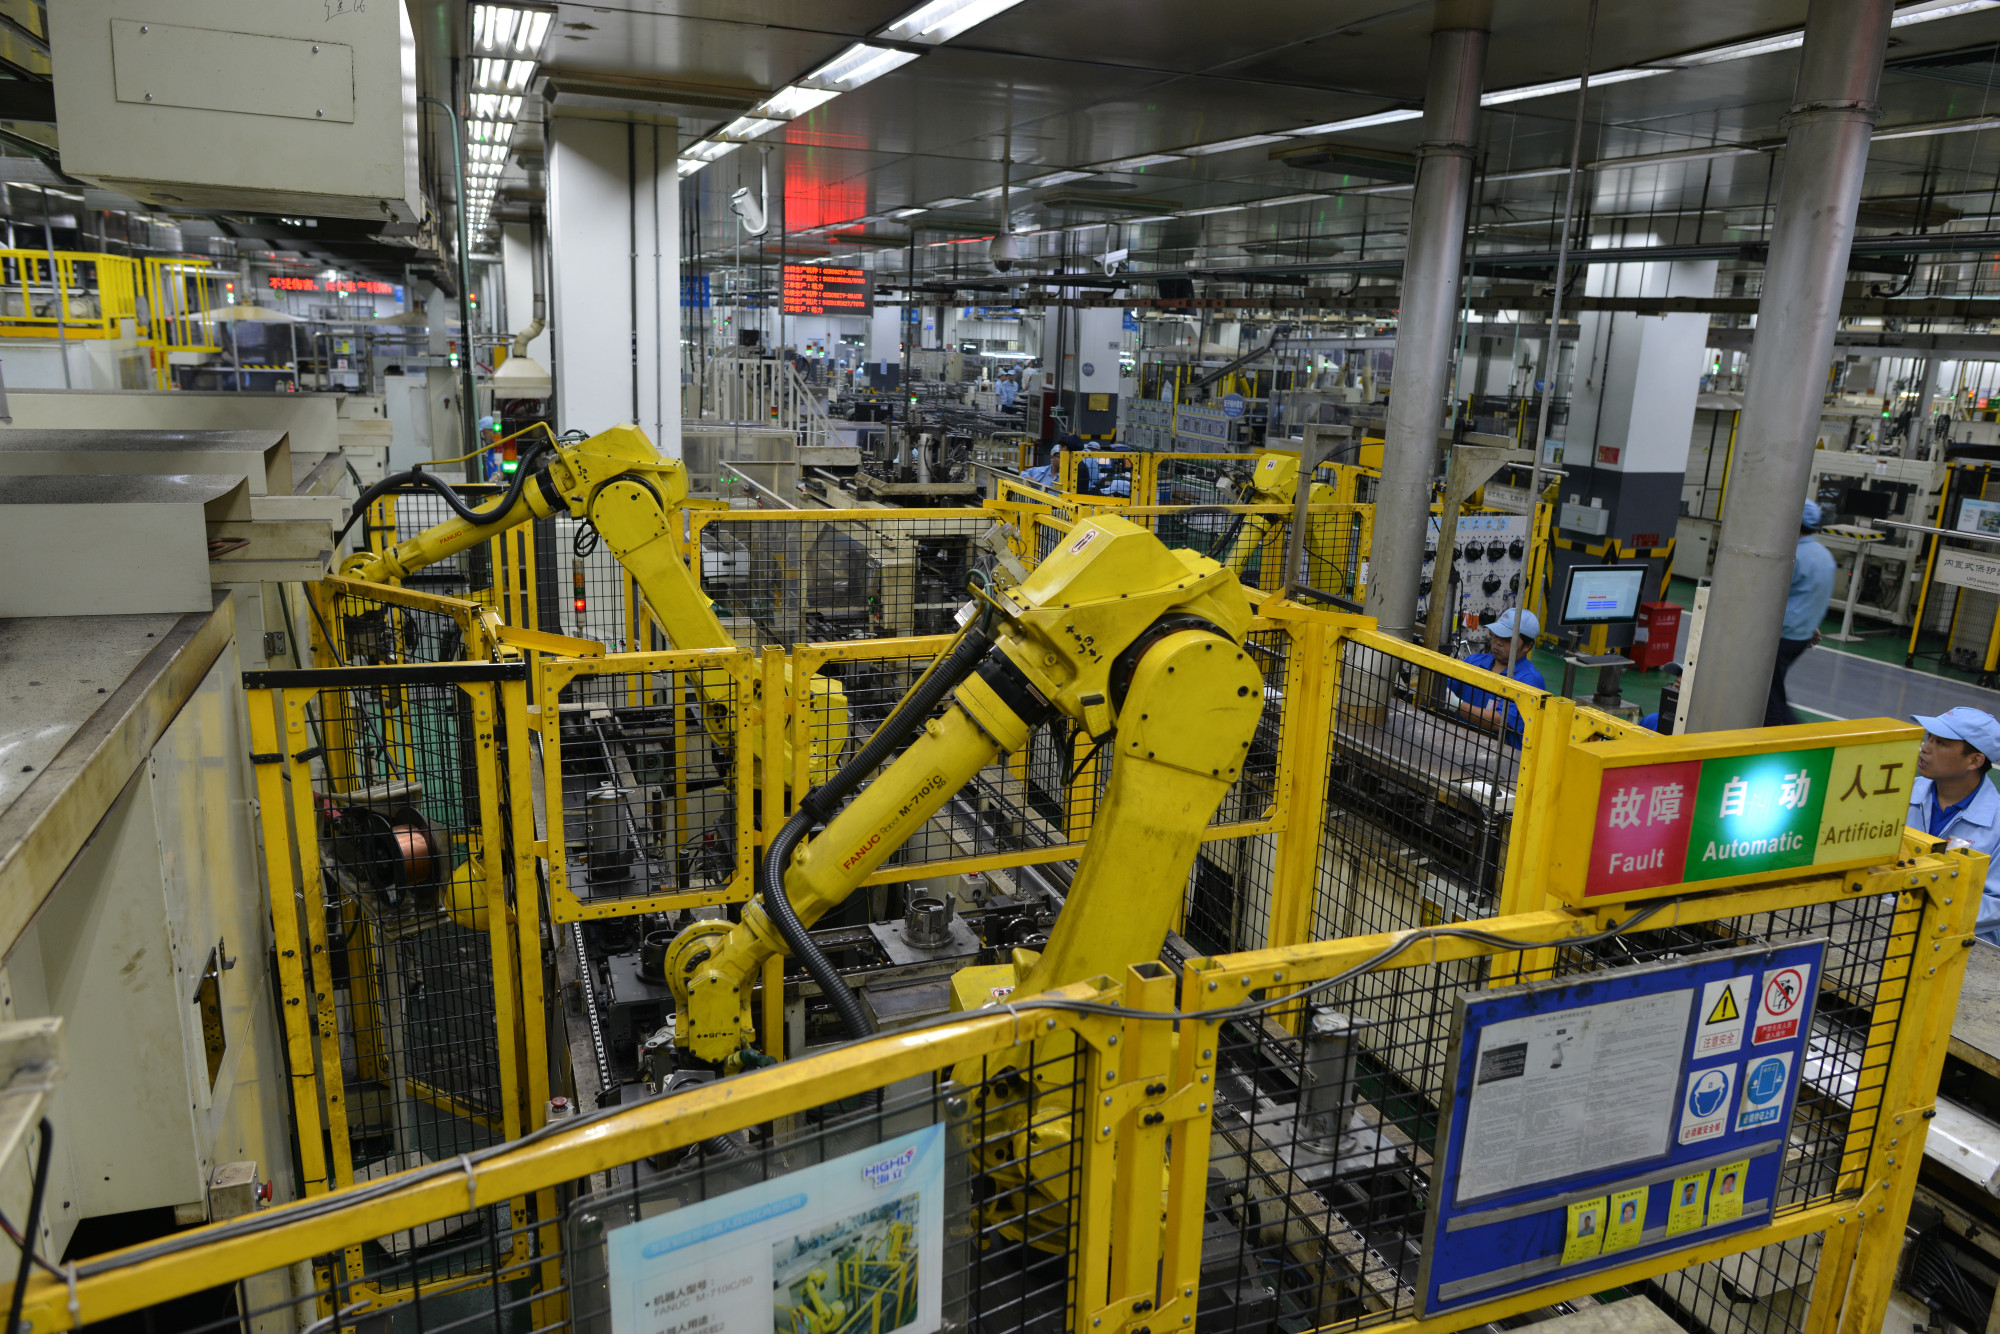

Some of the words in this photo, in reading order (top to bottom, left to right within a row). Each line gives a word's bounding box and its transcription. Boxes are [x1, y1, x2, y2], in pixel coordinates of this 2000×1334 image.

[439, 530, 463, 545] FANUC
[1719, 768, 1811, 818] 自动
[1840, 762, 1904, 801] 人工
[1608, 782, 1684, 829] 故障
[843, 834, 881, 870] FANUC
[879, 816, 901, 835] Robot
[1824, 819, 1899, 846] Artificial
[1702, 831, 1803, 862] Automatic
[1608, 849, 1664, 874] Fault
[1703, 1032, 1735, 1049] 注意安全
[865, 1152, 914, 1177] HIGHLY
[654, 1298, 690, 1317] FANUC
